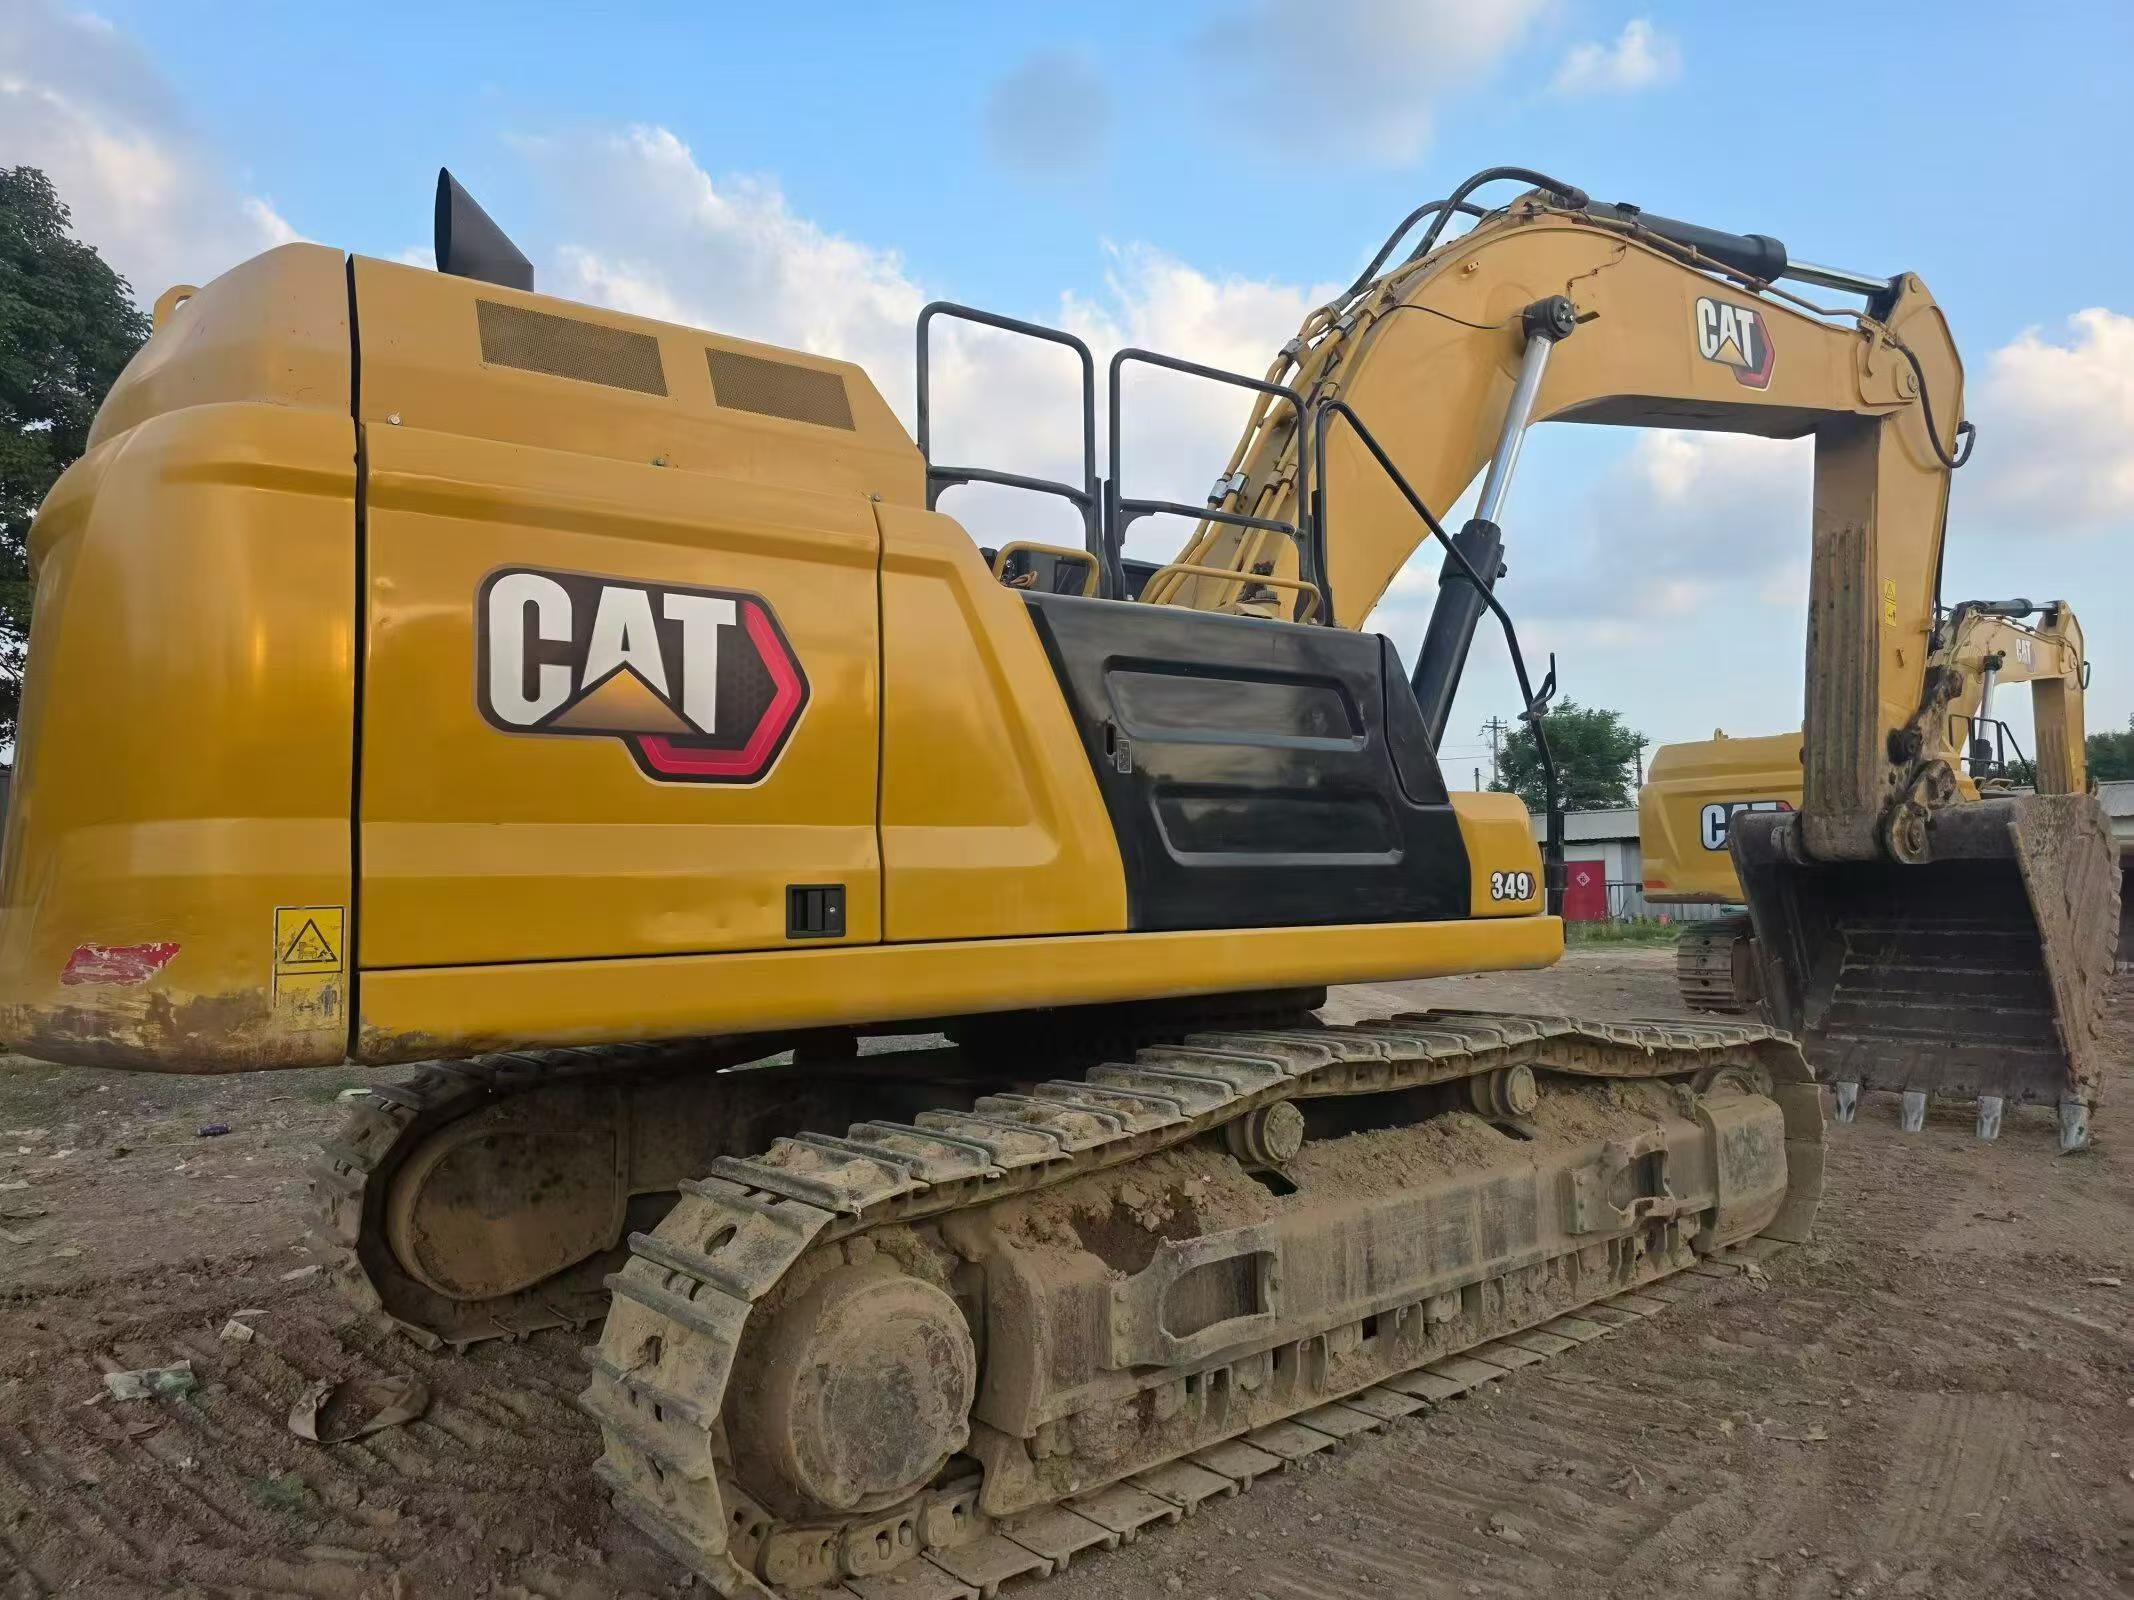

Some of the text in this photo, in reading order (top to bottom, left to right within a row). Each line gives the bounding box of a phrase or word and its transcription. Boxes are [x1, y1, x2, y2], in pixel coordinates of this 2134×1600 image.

[1696, 298, 1754, 368] CAT
[489, 573, 737, 734] CAT
[1491, 872, 1529, 899] 349
